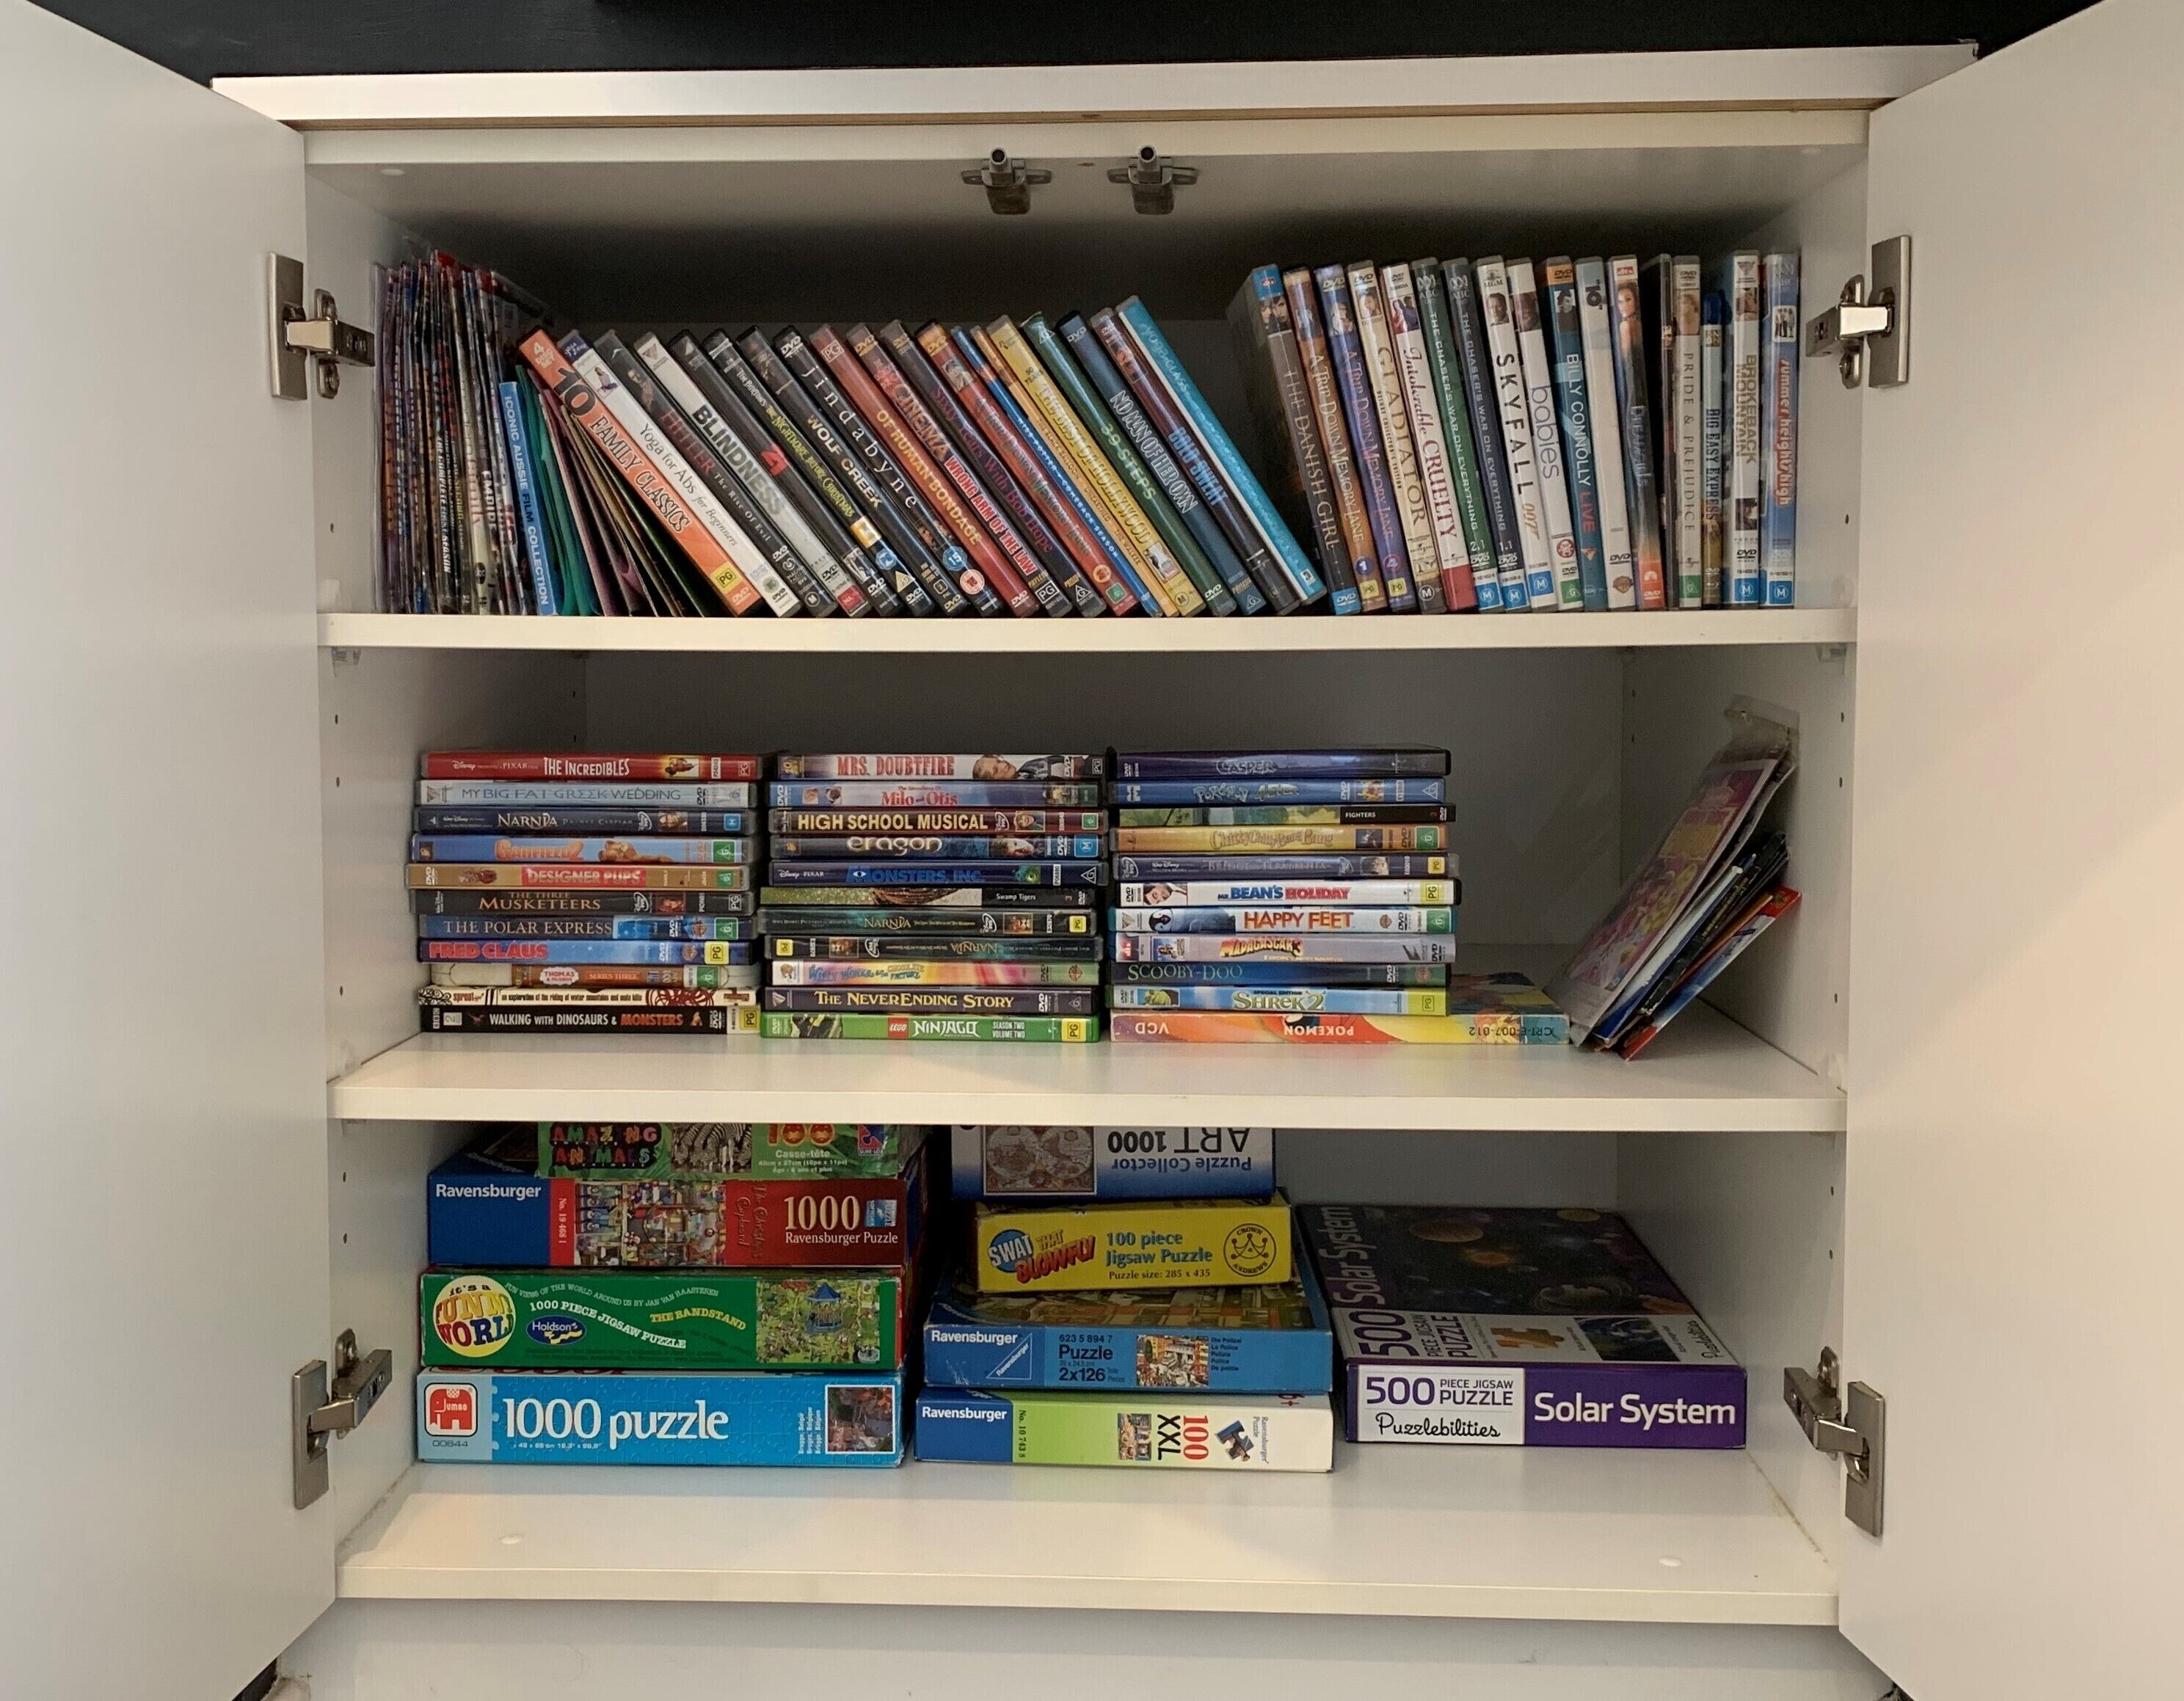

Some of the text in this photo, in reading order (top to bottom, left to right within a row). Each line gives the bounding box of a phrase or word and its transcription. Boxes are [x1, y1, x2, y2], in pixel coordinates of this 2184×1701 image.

[1483, 279, 1504, 288] MGM
[1736, 363, 1747, 456] MOUNTAIN
[1746, 354, 1757, 464] BROKEBACK
[1430, 313, 1477, 530] THE CHASER'S WAR ON EVERYTHING
[1496, 354, 1534, 495] SKYFALL
[1531, 385, 1559, 479] babies
[801, 365, 917, 508] jindabyne
[1377, 346, 1426, 525] GLADIATOR
[1404, 347, 1457, 538] Intolerable CRUELTY
[1566, 354, 1595, 533] BILLY CONNOLLY LIVE
[1684, 353, 1695, 530] PRIDE & PREJUDICE
[553, 368, 690, 532] 10 FAMILY CLASSICS
[692, 404, 784, 514] BLINDNESS
[1284, 371, 1340, 551] THE DANISH GIRL
[807, 415, 883, 509] WOLF CREEK
[1706, 409, 1720, 520] BIG EASY EXPRESS
[876, 409, 983, 545] OF HUMAN BONDAGE
[504, 396, 549, 605] ICONIC AUSSIE FILM COLLECTION
[944, 456, 1038, 575] WRONG ARM OF THE LAW
[544, 757, 630, 776] THE INCREDIBLES
[837, 756, 955, 776] MRS. DOUBTFIRE
[1216, 757, 1277, 775] CASPER
[498, 812, 558, 829] NARNIA
[798, 814, 989, 830] HIGH SCHOOL MUSICAL
[847, 837, 943, 856] eragon
[526, 869, 641, 884] DESIGNER PUPS
[778, 870, 799, 878] Disney
[479, 897, 601, 910] MUSKETEERS
[444, 921, 612, 935] THE POLAR EXPRESS
[863, 916, 911, 930] NARNIA
[1244, 911, 1354, 930] HAPPY FEET
[429, 942, 548, 959] FRED CLAUS
[1128, 964, 1242, 980] SCOOBY-DOO
[815, 991, 842, 1005] THE
[963, 994, 1015, 1008] STORY
[489, 1013, 683, 1026] WALKING WITH DINOSAURS & MONSTERS
[912, 1020, 980, 1038] NINJAGO
[1135, 1022, 1169, 1034] VCD
[992, 1030, 1025, 1038] VOLUME TWO
[1108, 1128, 1248, 1153] ART 1000
[776, 1149, 830, 1158] Casse-tête
[1113, 1157, 1251, 1172] Puzzle Collector
[436, 1184, 542, 1201] Ravensburger
[784, 1195, 860, 1231] 1000
[785, 1231, 898, 1245] Ravensburger Puzzle
[1106, 1231, 1183, 1250] 100 piece
[1237, 1227, 1263, 1236] CROWN
[1014, 1235, 1096, 1283] BLOWFLY
[1106, 1247, 1212, 1269] Jigsaw Puzzle
[1317, 1206, 1385, 1305] Solar System
[1109, 1270, 1139, 1279] Puzzle
[1142, 1270, 1162, 1279] size:
[1165, 1270, 1182, 1278] 285
[1194, 1269, 1210, 1277] 435
[1233, 1261, 1268, 1274] ANDREWS
[520, 1289, 539, 1297] VIEWS
[540, 1286, 549, 1296] OF
[551, 1283, 566, 1292] THE
[567, 1283, 593, 1297] WORLD
[593, 1291, 622, 1305] AROUND
[645, 1297, 660, 1306] JAN
[661, 1294, 675, 1304] VAN
[674, 1287, 719, 1297] HAASTEREN
[530, 1300, 559, 1312] 1000
[561, 1302, 598, 1319] PIECE
[597, 1312, 641, 1338] JIGSAW
[641, 1330, 686, 1349] PUZZLE
[532, 1322, 572, 1331] Holdson
[650, 1308, 746, 1330] THE BANDSTAND
[931, 1330, 1018, 1346] Ravensburger
[1430, 1315, 1477, 1358] PUZZLE
[996, 1343, 1030, 1376] Ravensburger
[1058, 1344, 1113, 1361] Puzzle
[1058, 1367, 1106, 1382] 2x126
[1366, 1377, 1513, 1405] 500 PIECE JIGSAW
[1440, 1391, 1513, 1406] PUZZLE
[922, 1407, 1007, 1421] Ravensburger
[1534, 1392, 1736, 1431] Solar System
[502, 1398, 729, 1451] 1000 puzzle
[1375, 1412, 1501, 1438] Puzzlebilities
[1157, 1414, 1181, 1460] XXL
[1183, 1415, 1209, 1460] 100
[1260, 1416, 1270, 1464] Ravensburger
